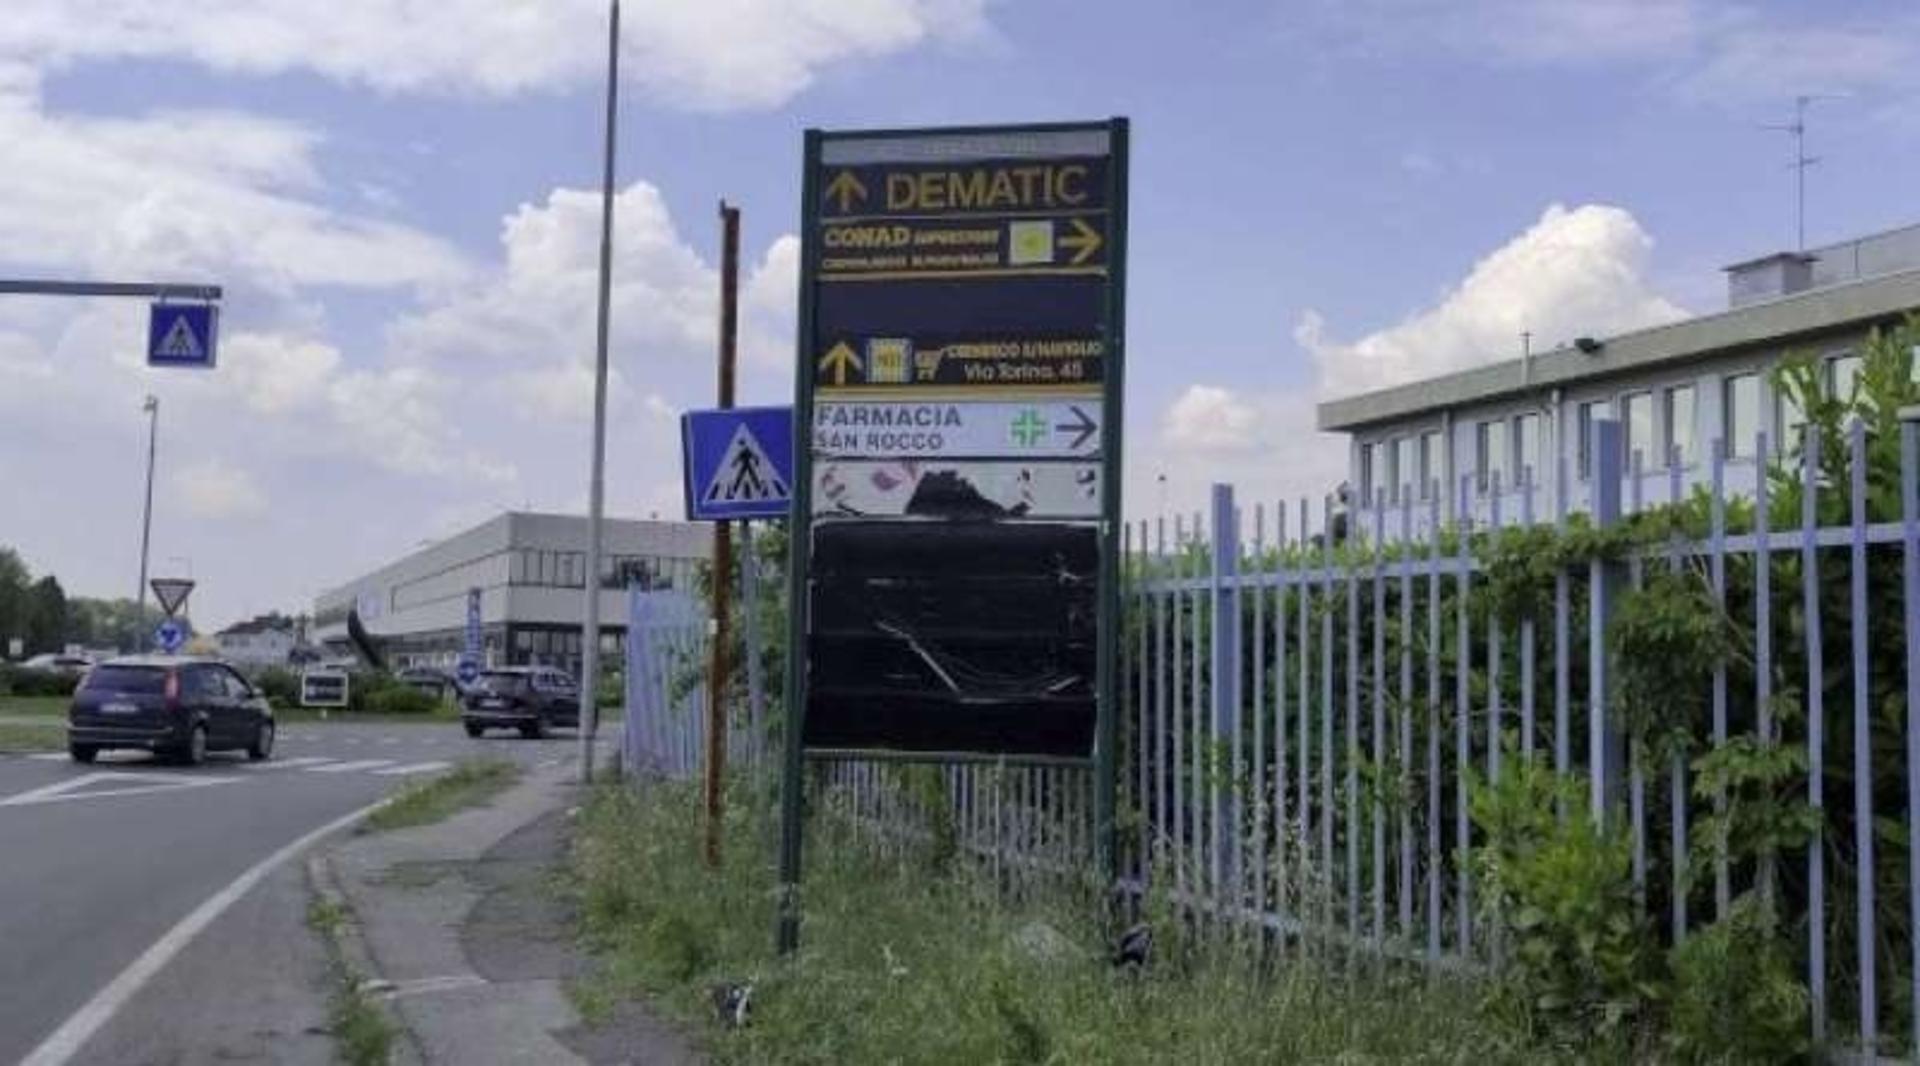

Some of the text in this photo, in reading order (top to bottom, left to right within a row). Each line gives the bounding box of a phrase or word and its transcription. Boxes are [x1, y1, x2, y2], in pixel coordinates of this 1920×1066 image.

[887, 166, 1087, 210] DEMATIC
[824, 227, 909, 248] CONAD
[963, 364, 995, 381] Via
[816, 405, 963, 427] FARMACIA
[815, 433, 944, 451] SAN ROCCO
